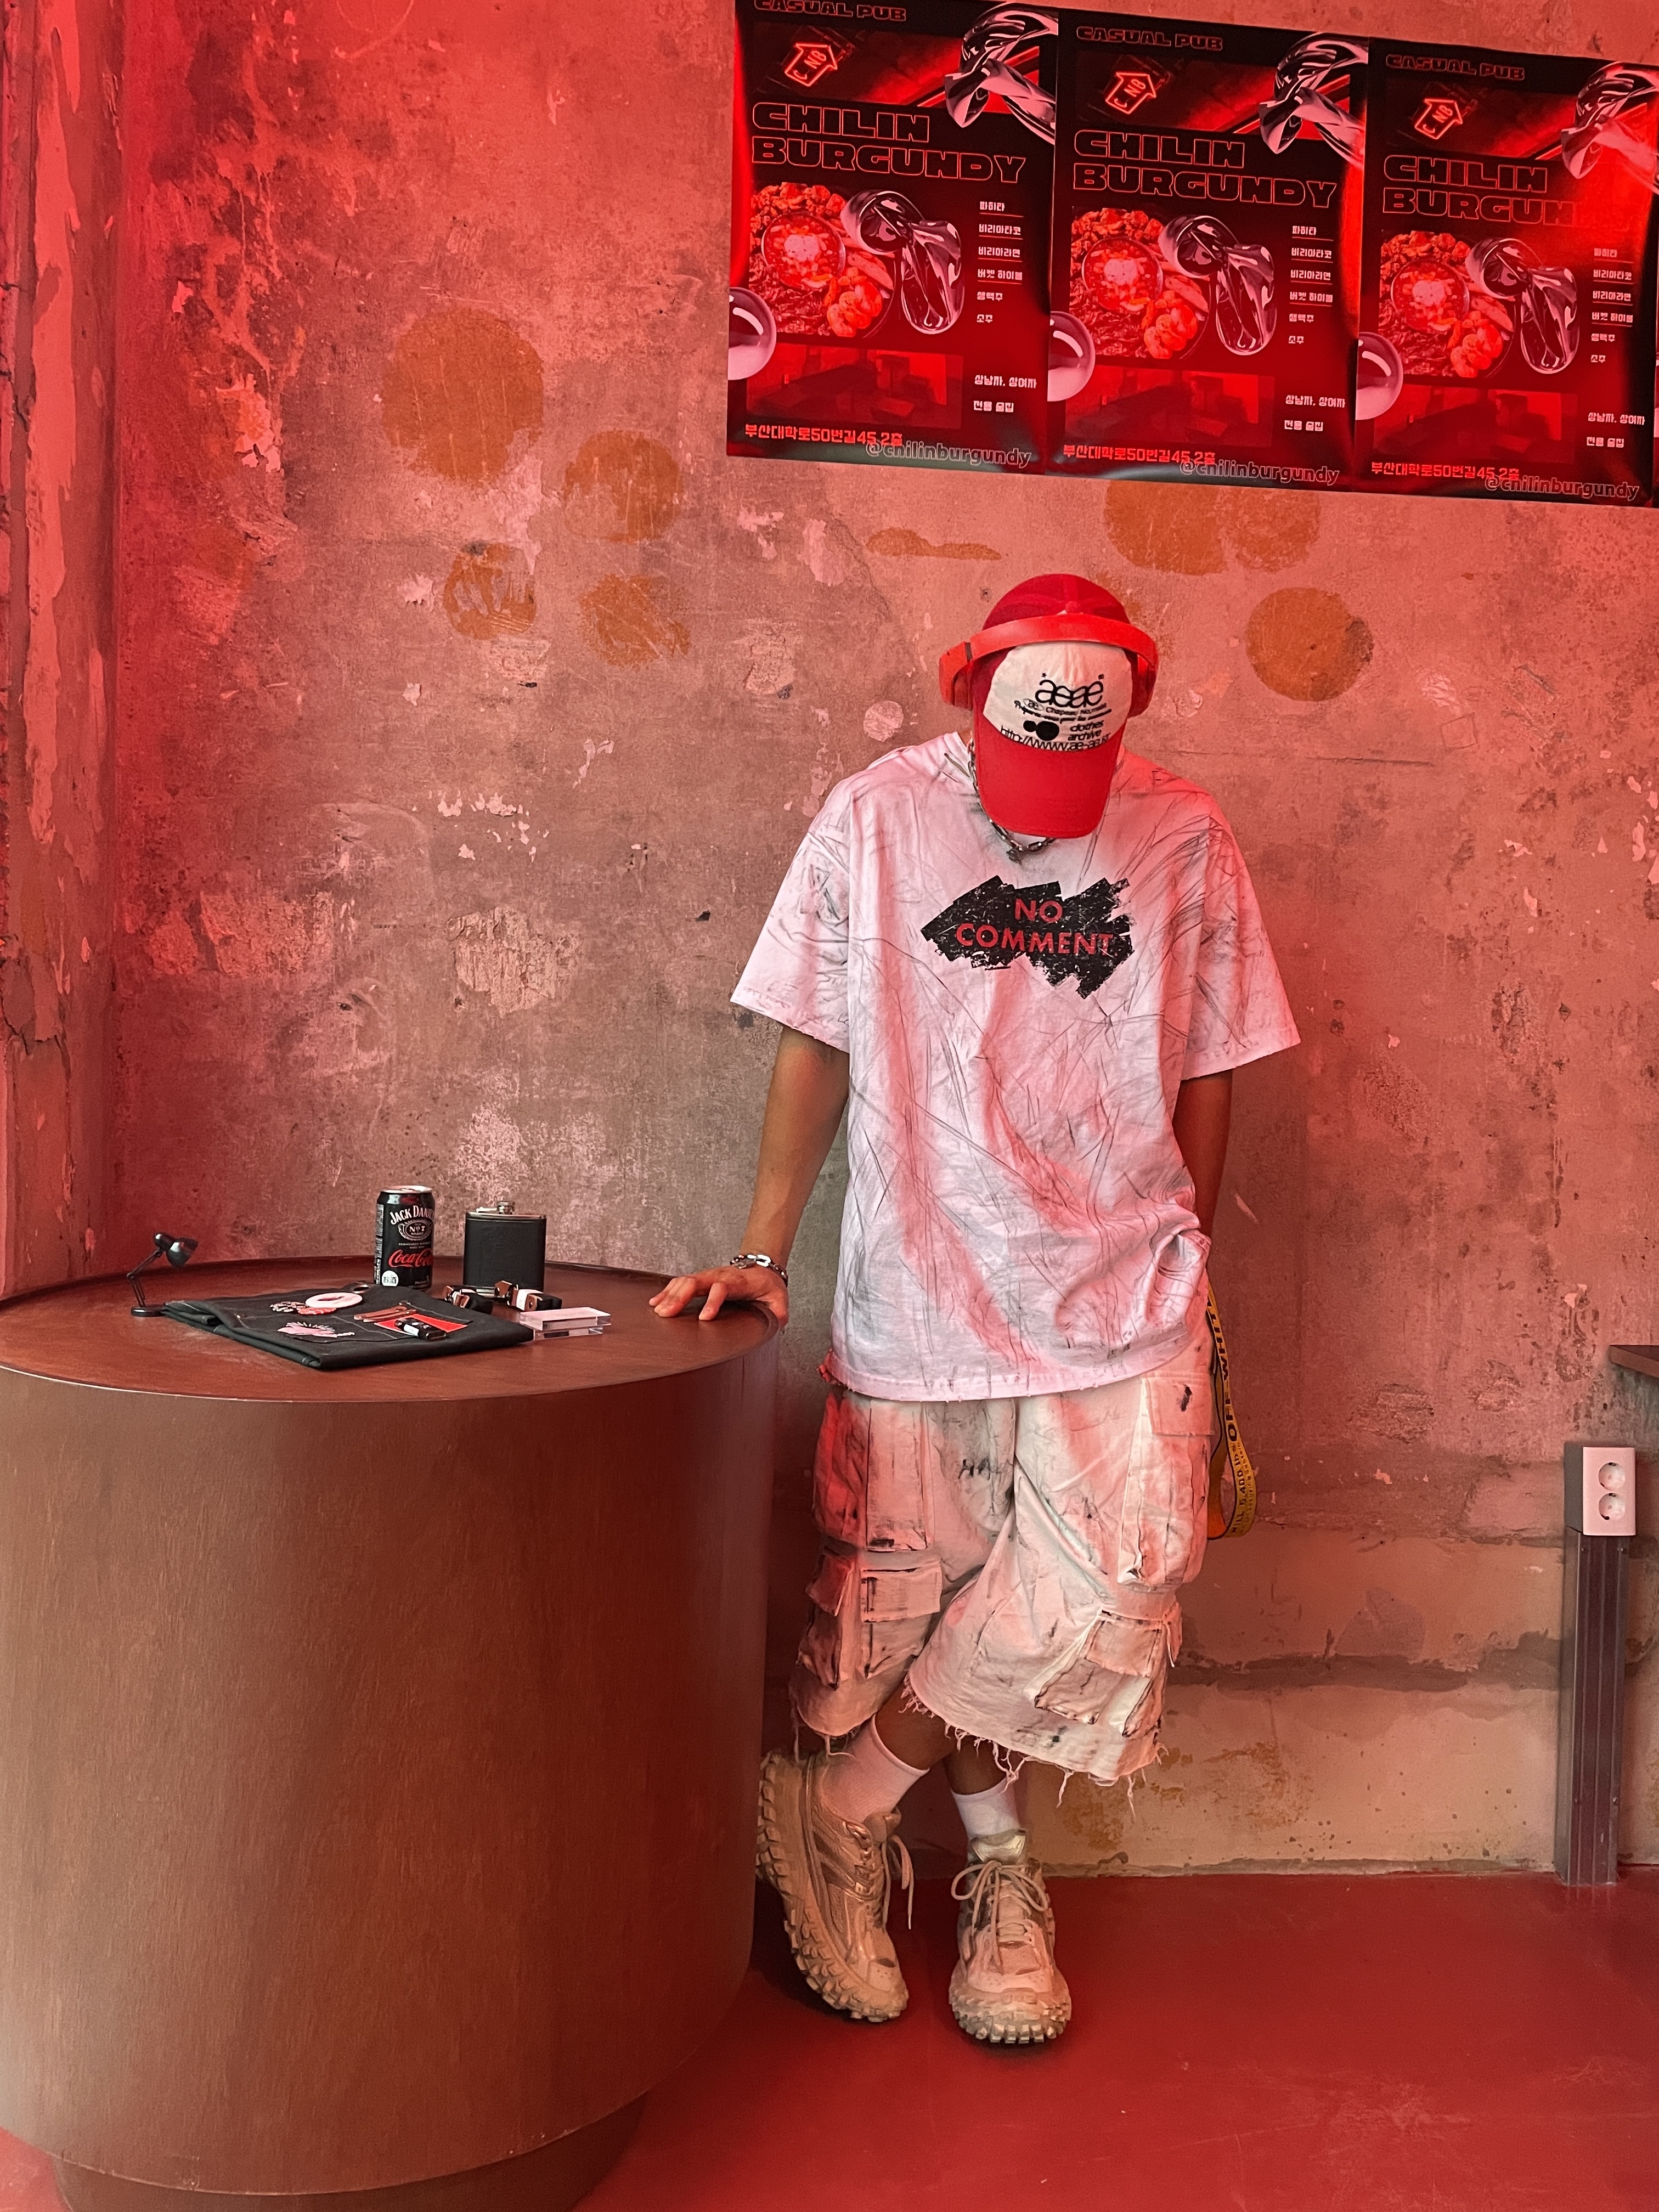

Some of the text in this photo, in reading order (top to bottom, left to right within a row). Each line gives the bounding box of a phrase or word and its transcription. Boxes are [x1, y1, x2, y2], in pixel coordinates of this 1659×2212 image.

[754, 0, 906, 21] CASUAL PUB
[1076, 26, 1223, 50] CASUAL PUB
[1385, 54, 1525, 81] CASUAL PUB
[753, 103, 929, 143] CHILIN
[1074, 129, 1244, 168] CHILIN
[752, 136, 1026, 183] BURGUNDY
[1384, 154, 1547, 193] CHILIN
[1073, 163, 1337, 208] BURGUNDY
[1383, 187, 1580, 227] BURGUN
[978, 246, 1020, 258] 비리아라면
[1290, 269, 1331, 281] 비리아라면
[977, 291, 1003, 301] 생맥주
[977, 314, 993, 323] 소주
[1289, 313, 1314, 323] 생맥주
[1288, 335, 1304, 344] 소주
[1590, 354, 1606, 363] 소주
[1009, 377, 1037, 388] 상여자
[974, 400, 1014, 413] 전용 술집
[1318, 397, 1346, 408] 상여자
[1284, 420, 1324, 432] 전용 술집
[1620, 414, 1645, 425] 상여자
[866, 439, 1031, 469] @chilinburgundy
[1180, 459, 1340, 486] @chilinburgundy
[1485, 475, 1640, 501] @chilinburgundy
[1014, 898, 1063, 923] NO
[956, 923, 1114, 956] COMMENT
[390, 1209, 412, 1225] JACK
